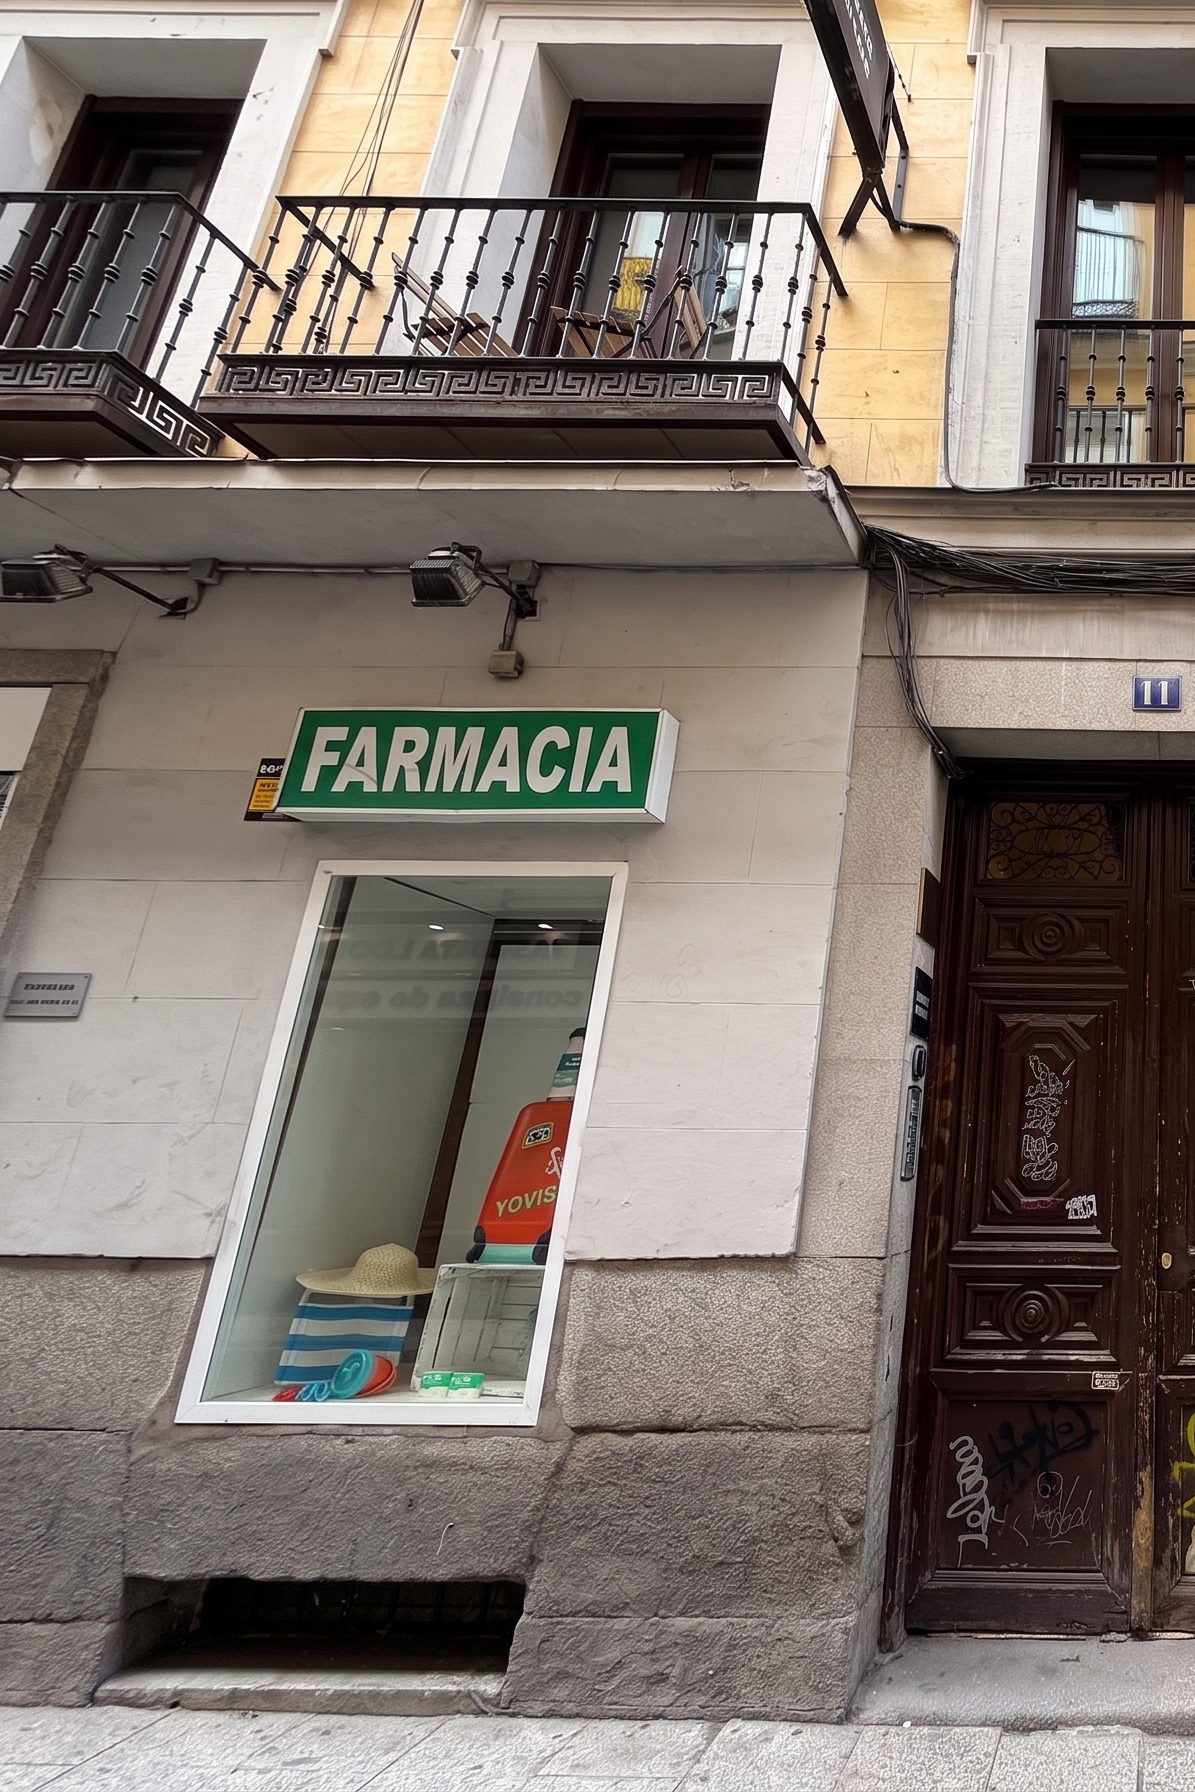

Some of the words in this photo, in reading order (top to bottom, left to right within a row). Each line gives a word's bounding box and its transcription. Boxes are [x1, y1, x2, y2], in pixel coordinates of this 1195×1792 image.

[1140, 680, 1169, 705] 11
[300, 725, 632, 794] FARMACIA
[495, 1185, 557, 1218] YOVIS
